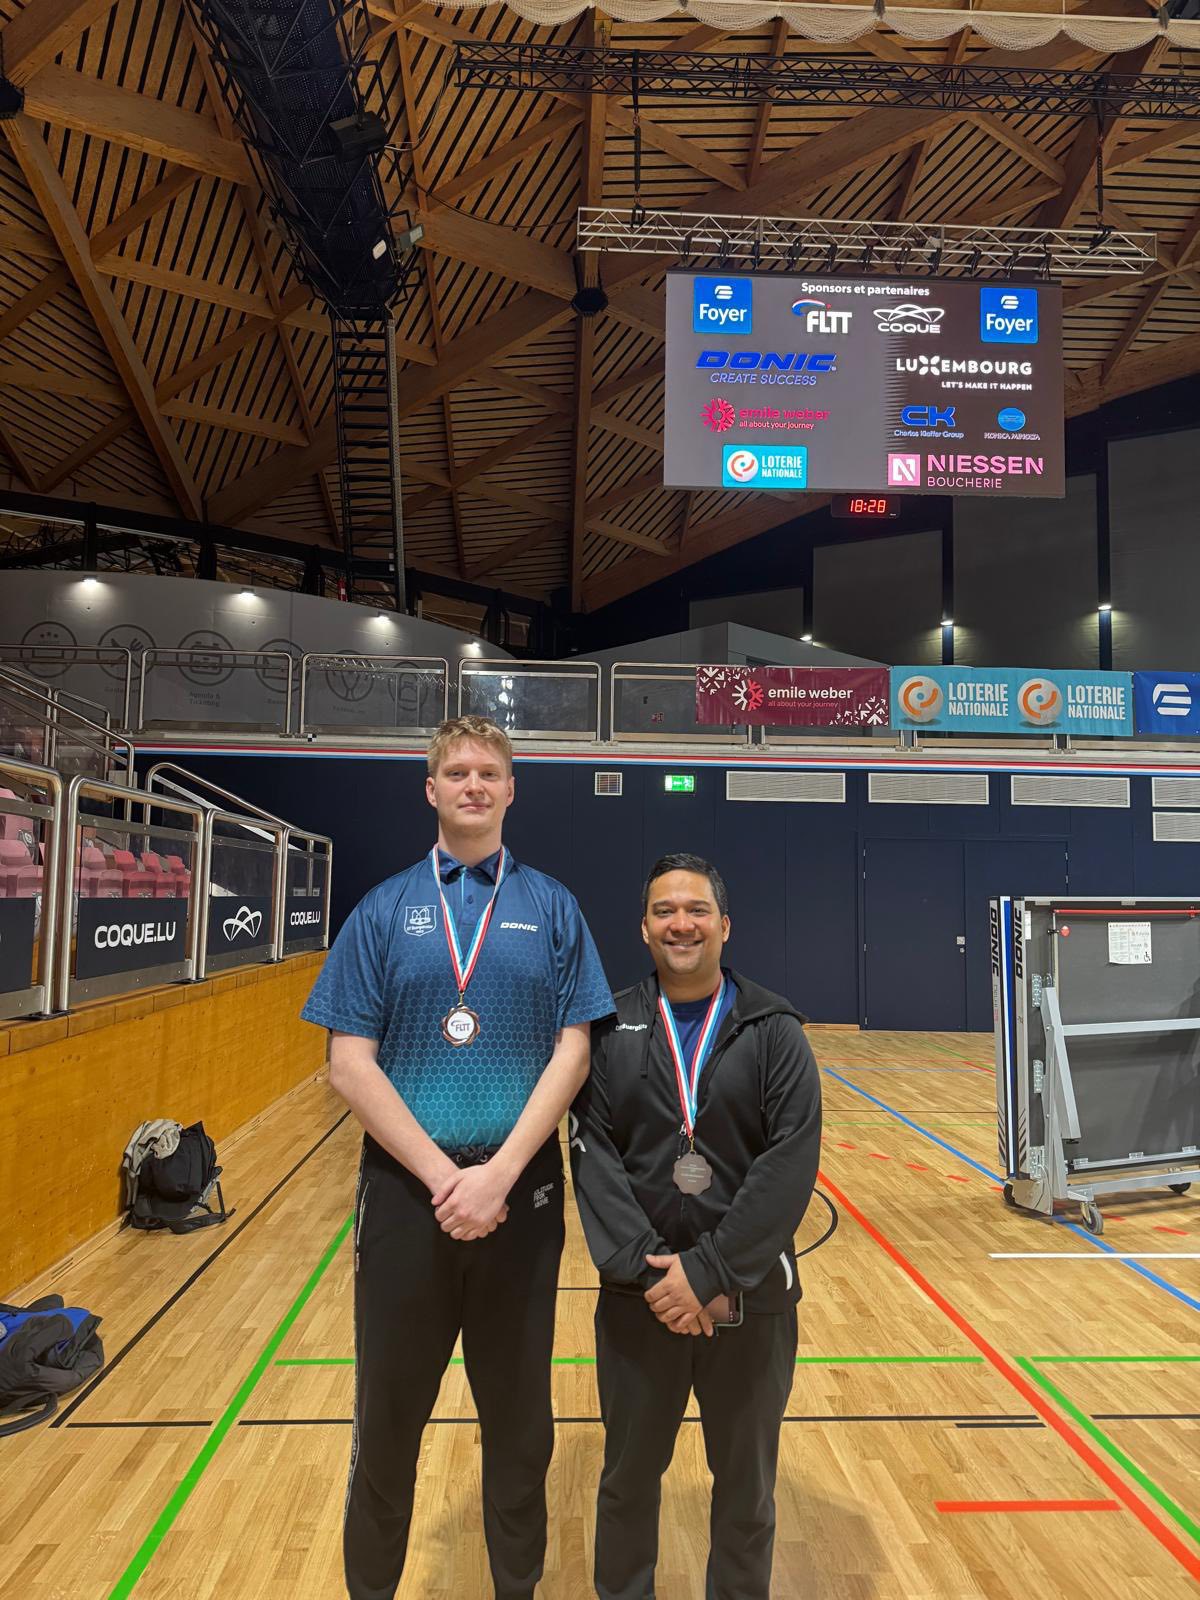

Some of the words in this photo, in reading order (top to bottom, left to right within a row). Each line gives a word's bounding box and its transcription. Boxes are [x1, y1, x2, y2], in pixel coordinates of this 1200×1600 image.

[801, 282, 852, 294] Sponsors
[854, 285, 865, 294] et
[867, 285, 930, 296] partenaires
[699, 303, 748, 325] Foyer
[806, 310, 853, 334] FLTT
[877, 322, 941, 334] COQUE
[986, 313, 1034, 335] Foyer
[695, 350, 836, 372] DONIC
[896, 355, 1033, 376] LUXEMBOURG
[710, 372, 758, 384] CREATE
[760, 373, 817, 386] SUCCESS
[941, 381, 963, 389] LET'S
[990, 382, 998, 390] IT
[1000, 383, 1033, 391] HAPPEN
[739, 406, 781, 420] emile
[783, 408, 831, 421] weber
[901, 405, 956, 427] CK
[749, 421, 770, 429] about
[787, 422, 815, 430] journey
[942, 430, 965, 439] Group
[761, 455, 803, 468] LOTERIE
[927, 454, 1044, 475] NIESSEN
[761, 468, 802, 479] NATIONALE
[927, 476, 1002, 489] BOUCHERIE
[850, 499, 886, 513] 18:28
[768, 686, 806, 699] emile
[808, 687, 854, 699] weber
[948, 682, 1008, 702] LOTERIE
[1067, 685, 1125, 706] LOTERIE
[812, 701, 838, 709] journey
[948, 702, 1009, 717] NATIONALE
[1067, 704, 1126, 720] NATIONALE
[290, 911, 321, 926] COQUE.LU
[500, 921, 539, 932] DONIC
[94, 921, 176, 949] COQUE.LU
[990, 908, 1000, 977] DONIC
[1014, 907, 1023, 980] DONIC
[455, 1023, 471, 1032] FLTT
